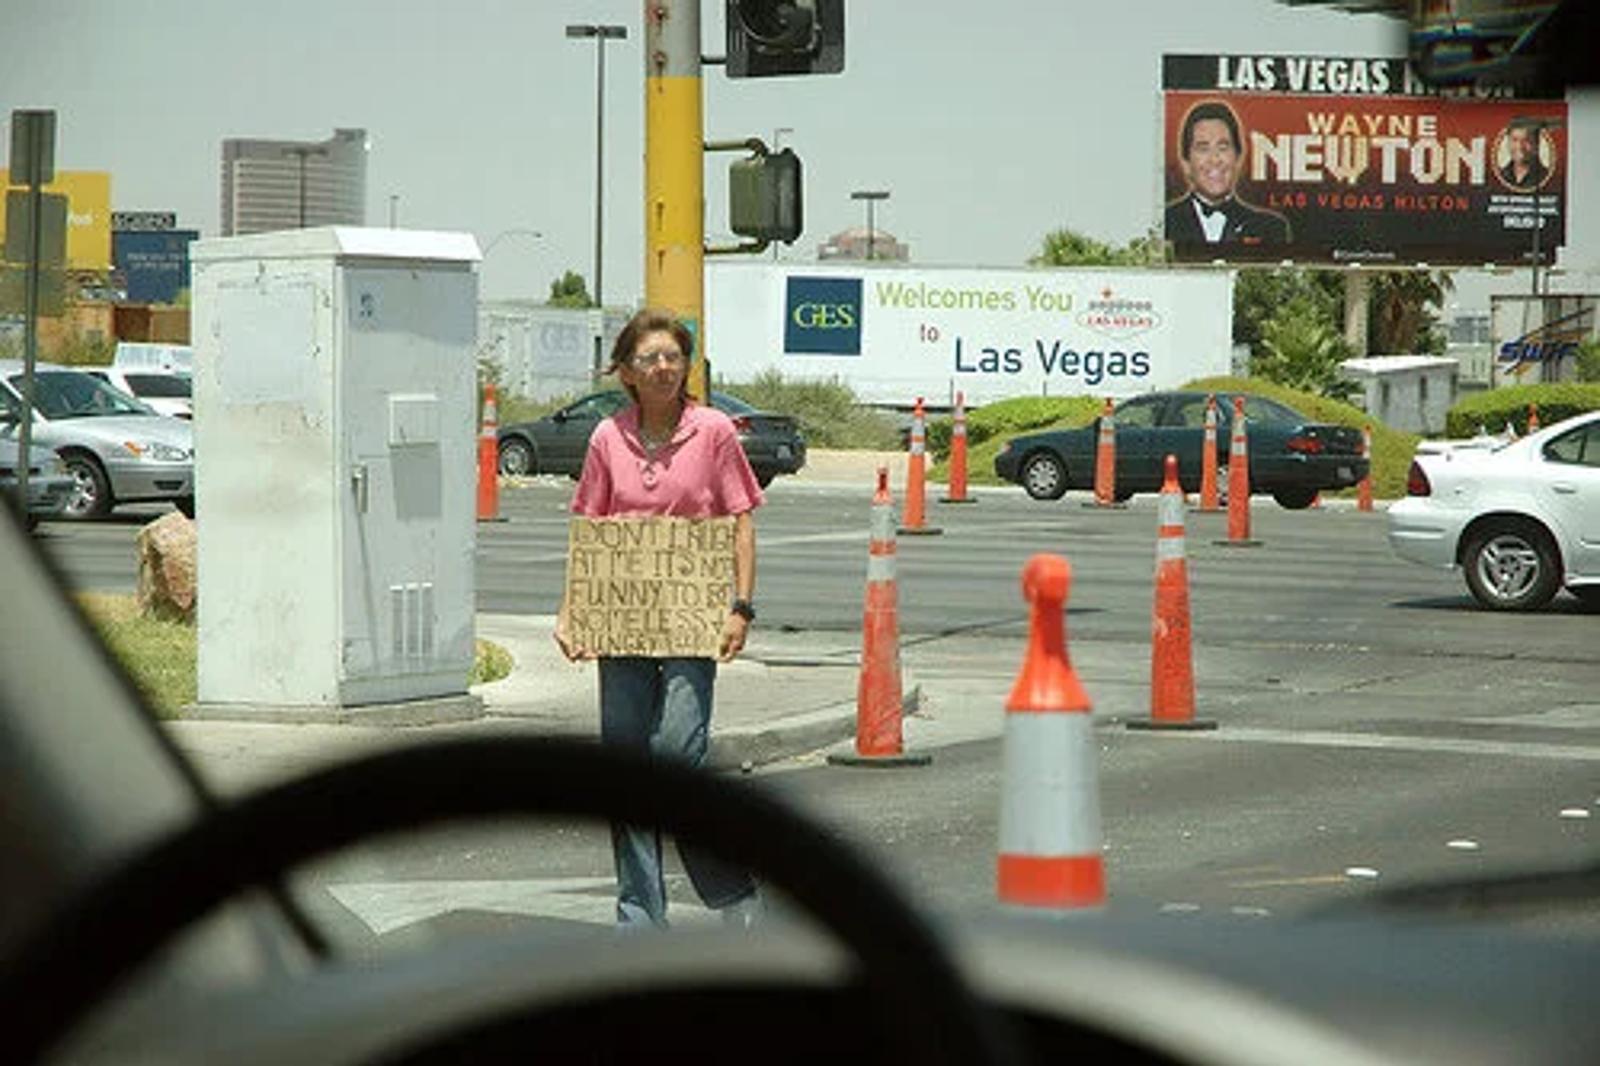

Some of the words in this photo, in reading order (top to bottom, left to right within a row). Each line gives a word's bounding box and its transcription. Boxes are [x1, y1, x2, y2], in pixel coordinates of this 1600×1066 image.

[1217, 57, 1277, 89] LAS
[1286, 58, 1390, 93] VEGAS
[1307, 112, 1437, 137] WAYNE
[1251, 130, 1486, 184] NEWTON
[1268, 192, 1308, 208] LAS
[1317, 193, 1384, 209] VEGAS
[1394, 196, 1470, 211] HILTON
[876, 281, 1017, 310] Welcomes
[1024, 286, 1073, 312] You
[793, 302, 857, 329] GES
[920, 323, 940, 343] to
[955, 336, 1023, 374] Las
[1036, 339, 1151, 386] Vegas
[570, 578, 663, 609] FUNNY
[667, 579, 701, 607] TO
